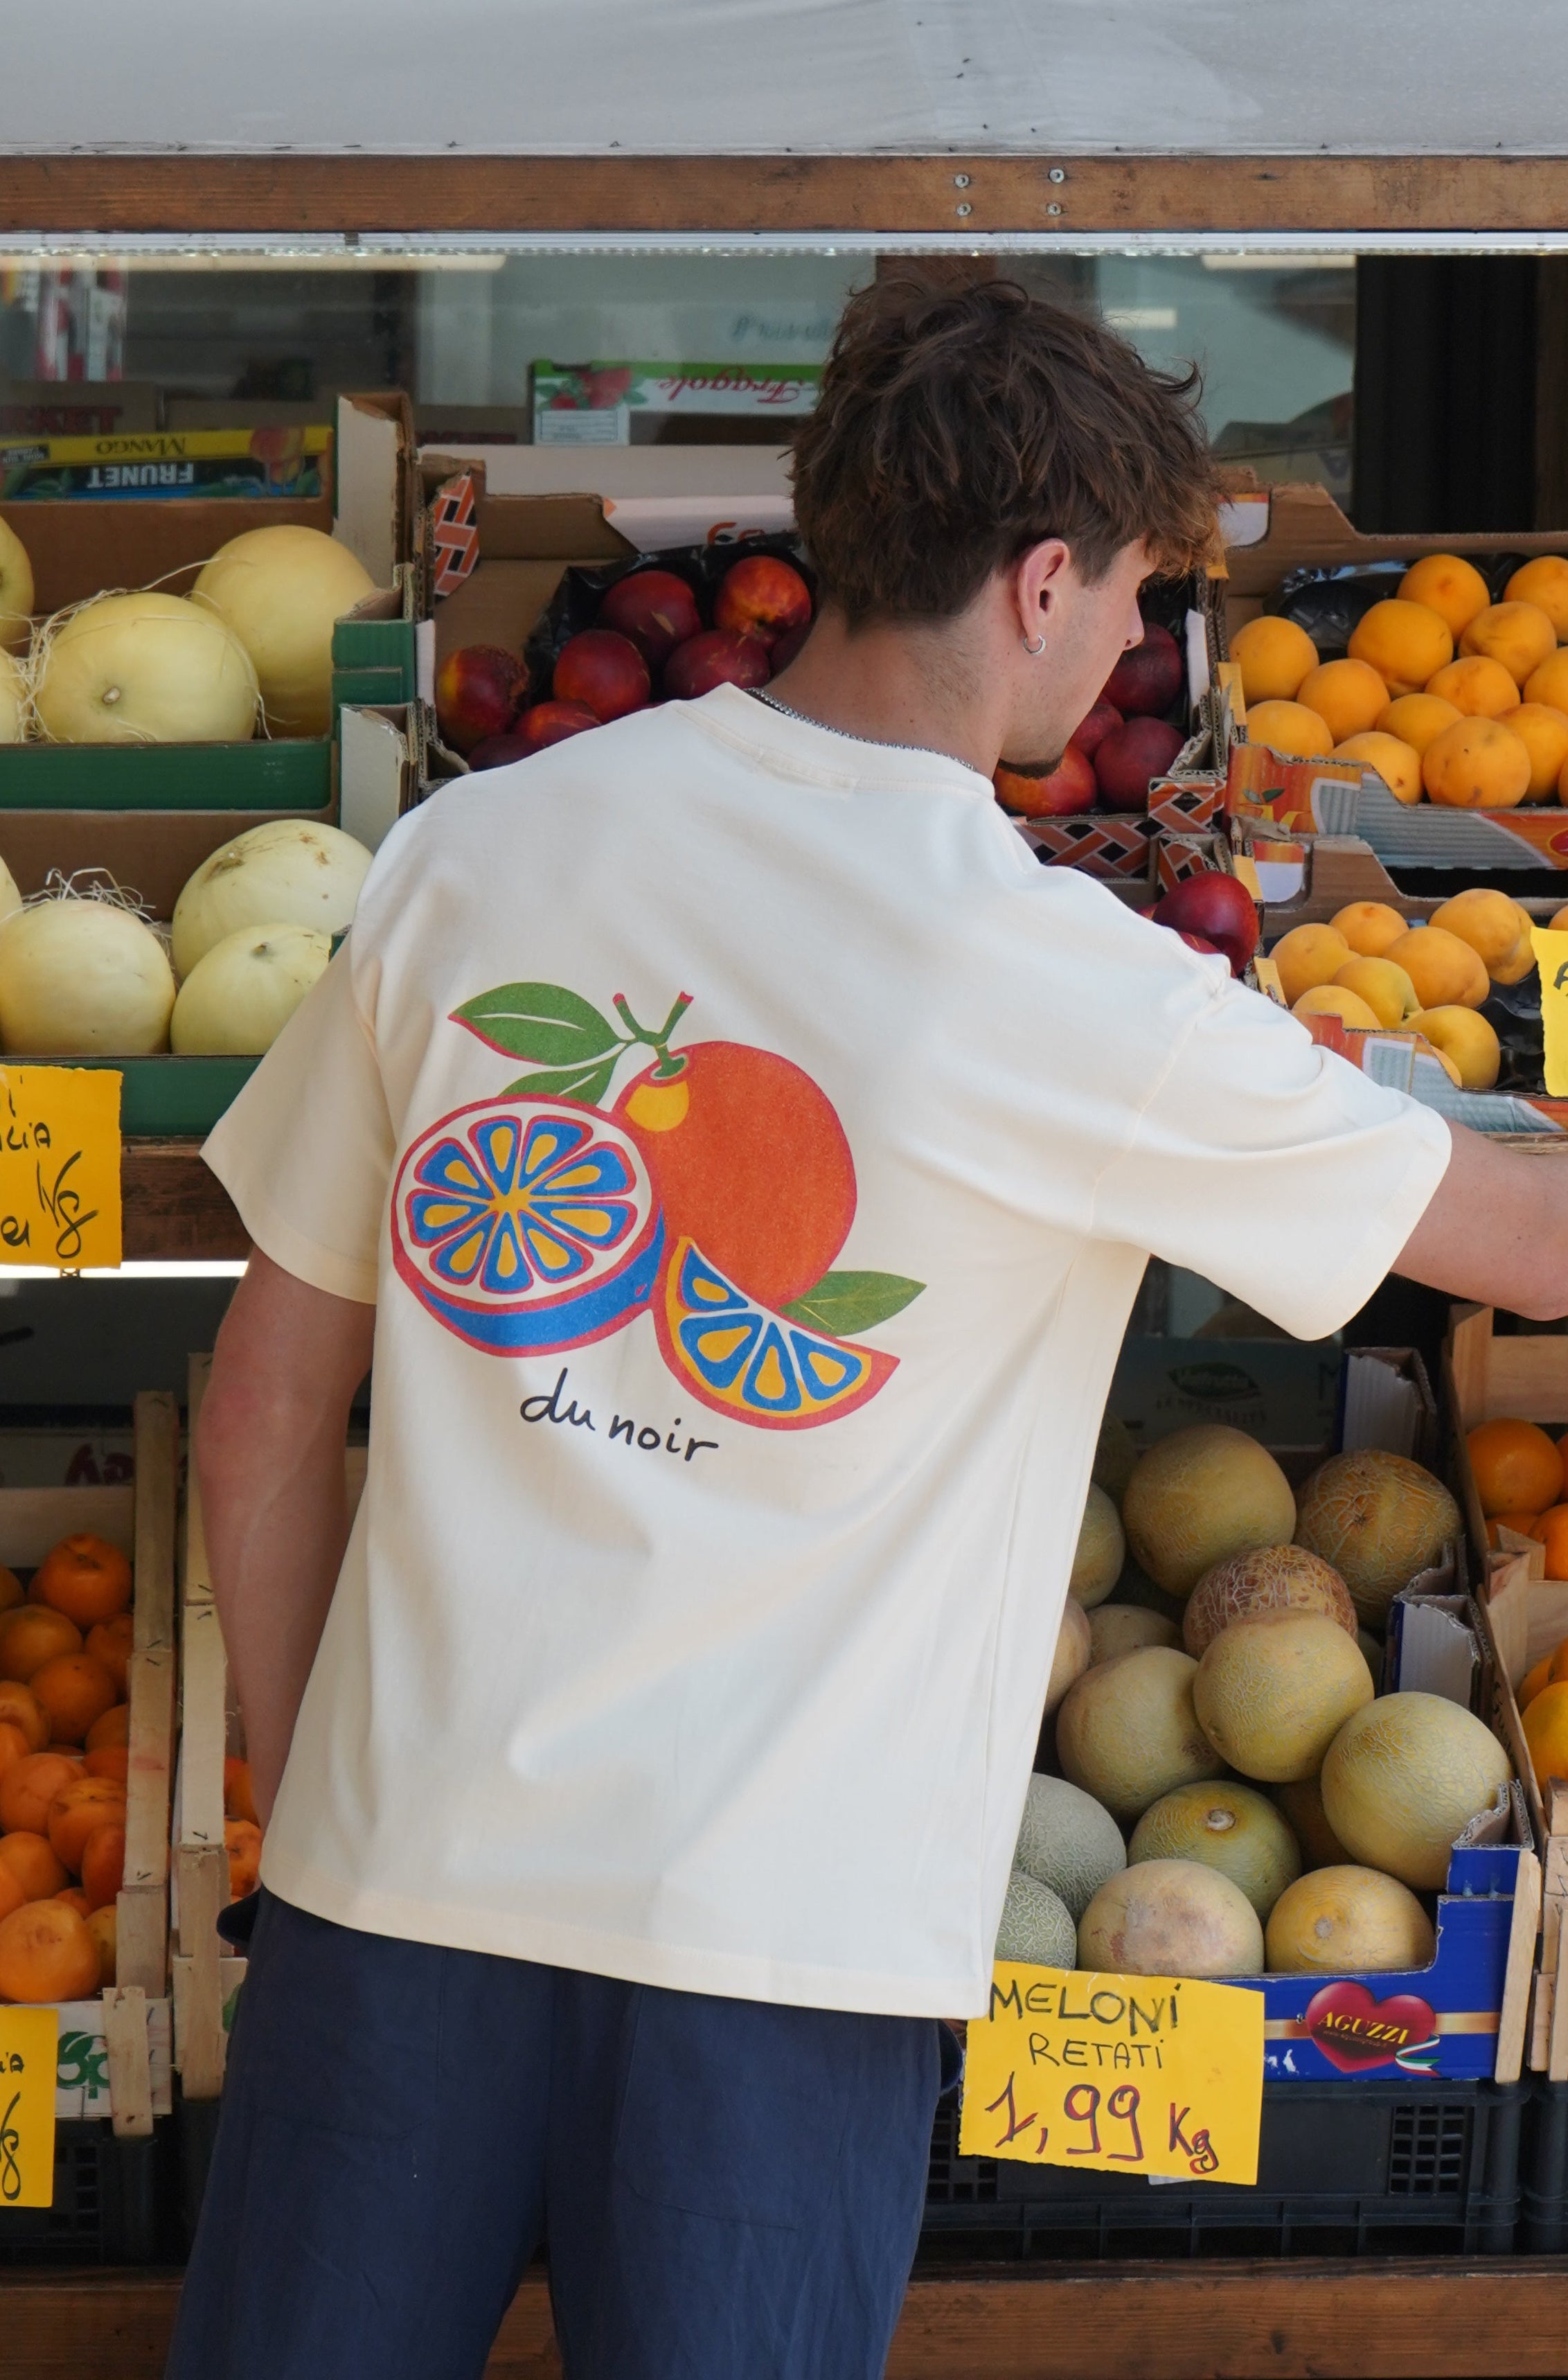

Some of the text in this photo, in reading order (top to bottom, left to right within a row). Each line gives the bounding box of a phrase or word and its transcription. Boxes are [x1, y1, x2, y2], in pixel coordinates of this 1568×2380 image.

[655, 367, 805, 405] Fragole
[96, 436, 186, 456] MANGO
[87, 462, 195, 489] FRUNET
[520, 1367, 719, 1462] du noir
[1317, 2011, 1411, 2045] AGUZZI
[984, 2071, 1220, 2175] 1,99 Kg
